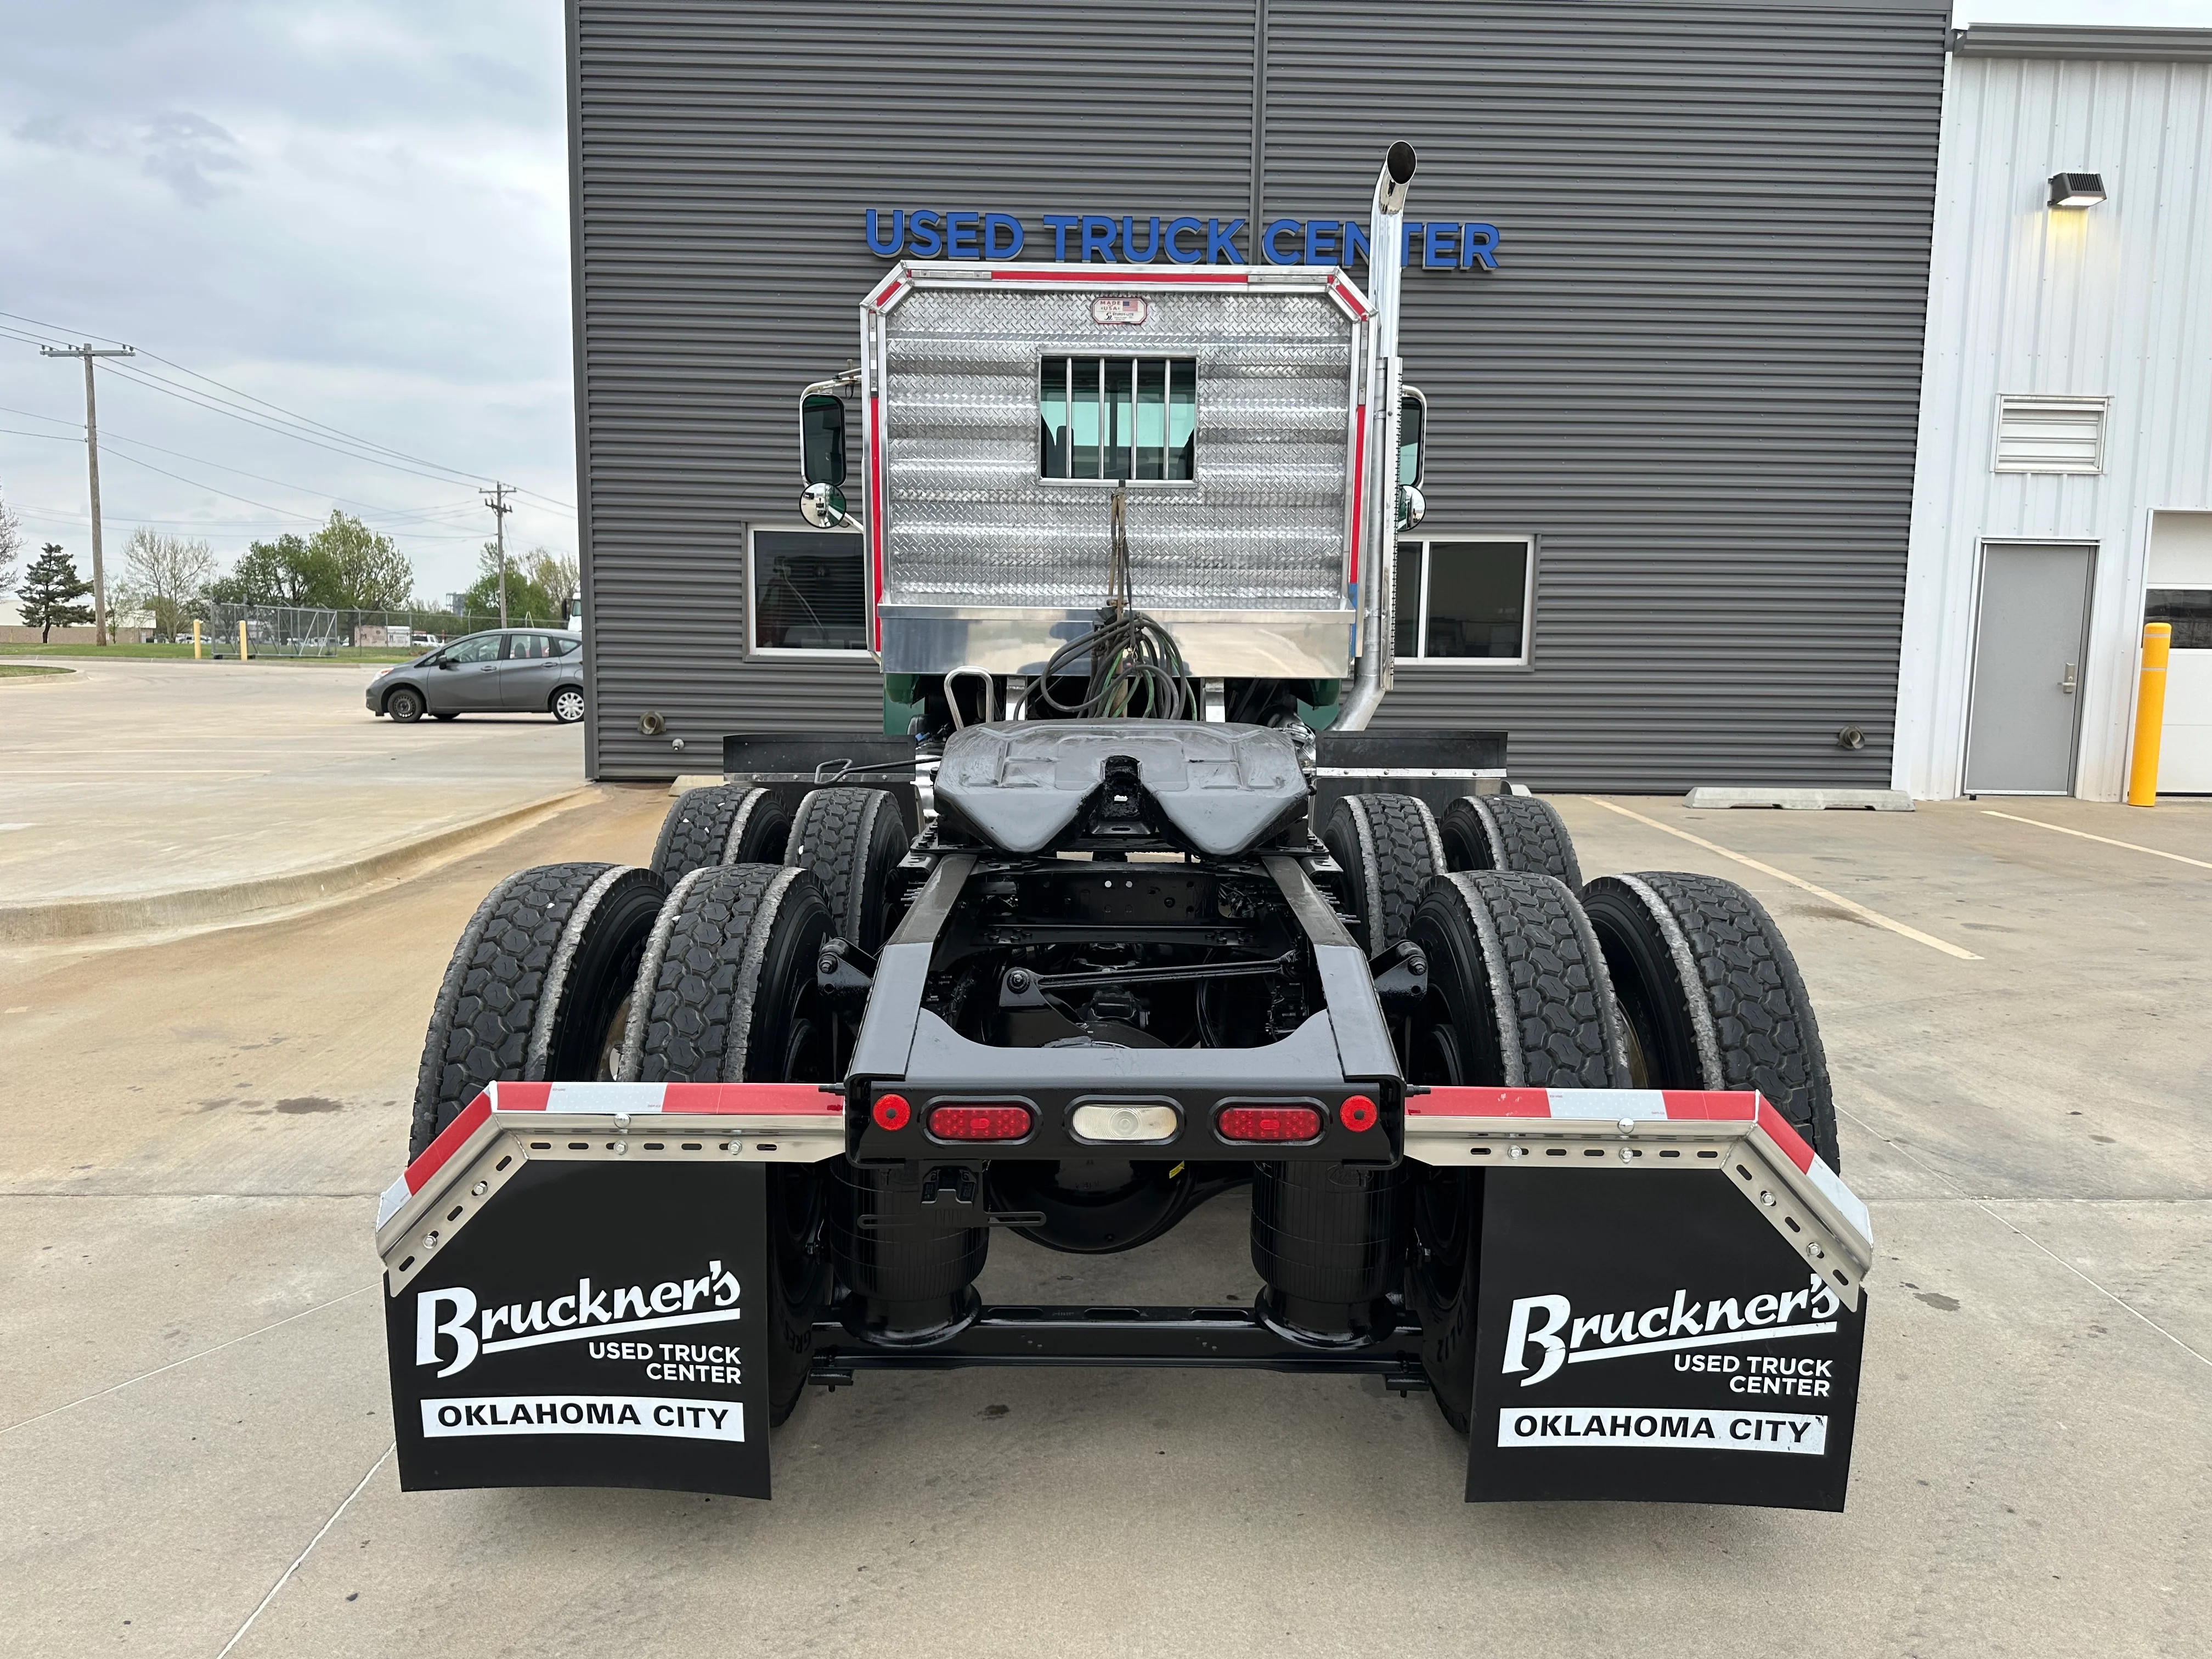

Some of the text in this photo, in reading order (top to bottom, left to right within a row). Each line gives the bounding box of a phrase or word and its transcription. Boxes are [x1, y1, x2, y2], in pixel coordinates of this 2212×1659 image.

[866, 209, 1500, 270] USED TRUCK CENTER
[416, 1261, 740, 1378] Bruckner's
[1502, 1273, 1839, 1387] Bruckner's
[589, 1342, 741, 1364] USED TRUCK
[1675, 1354, 1832, 1378] USED TRUCK
[646, 1363, 741, 1384] CENTER
[1730, 1375, 1830, 1397] CENTER
[438, 1403, 729, 1430] OKLAHOMA CITY
[1514, 1415, 1812, 1443] OKLAHOMA CITY
